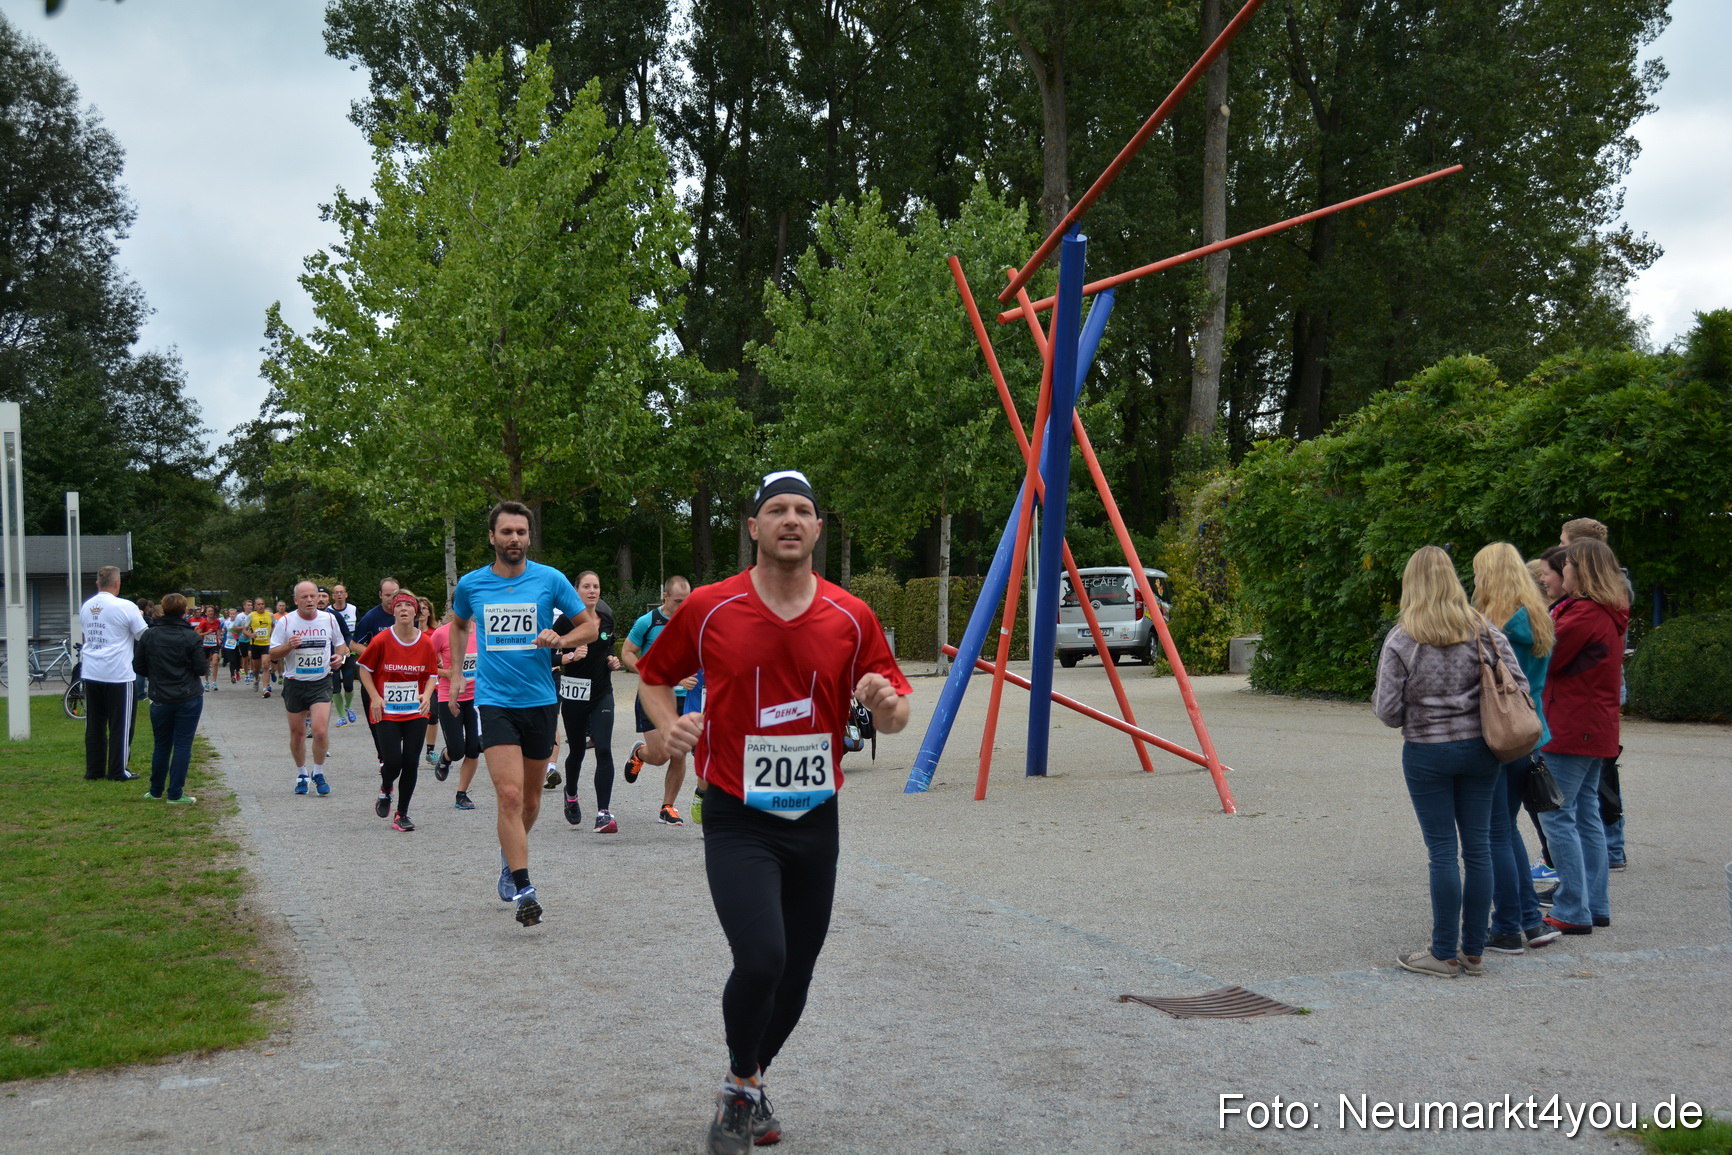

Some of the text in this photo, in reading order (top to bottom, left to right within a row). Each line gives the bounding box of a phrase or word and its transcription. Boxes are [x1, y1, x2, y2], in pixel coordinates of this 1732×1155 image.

[490, 615, 533, 632] 2276
[293, 627, 327, 636] twinn
[298, 656, 323, 667] 2449
[463, 660, 476, 670] 82
[388, 690, 416, 702] 2377
[775, 706, 798, 719] DEHN
[747, 742, 819, 753] PARTL Neumarkt
[755, 755, 827, 787] 2043
[772, 796, 811, 808] Robert
